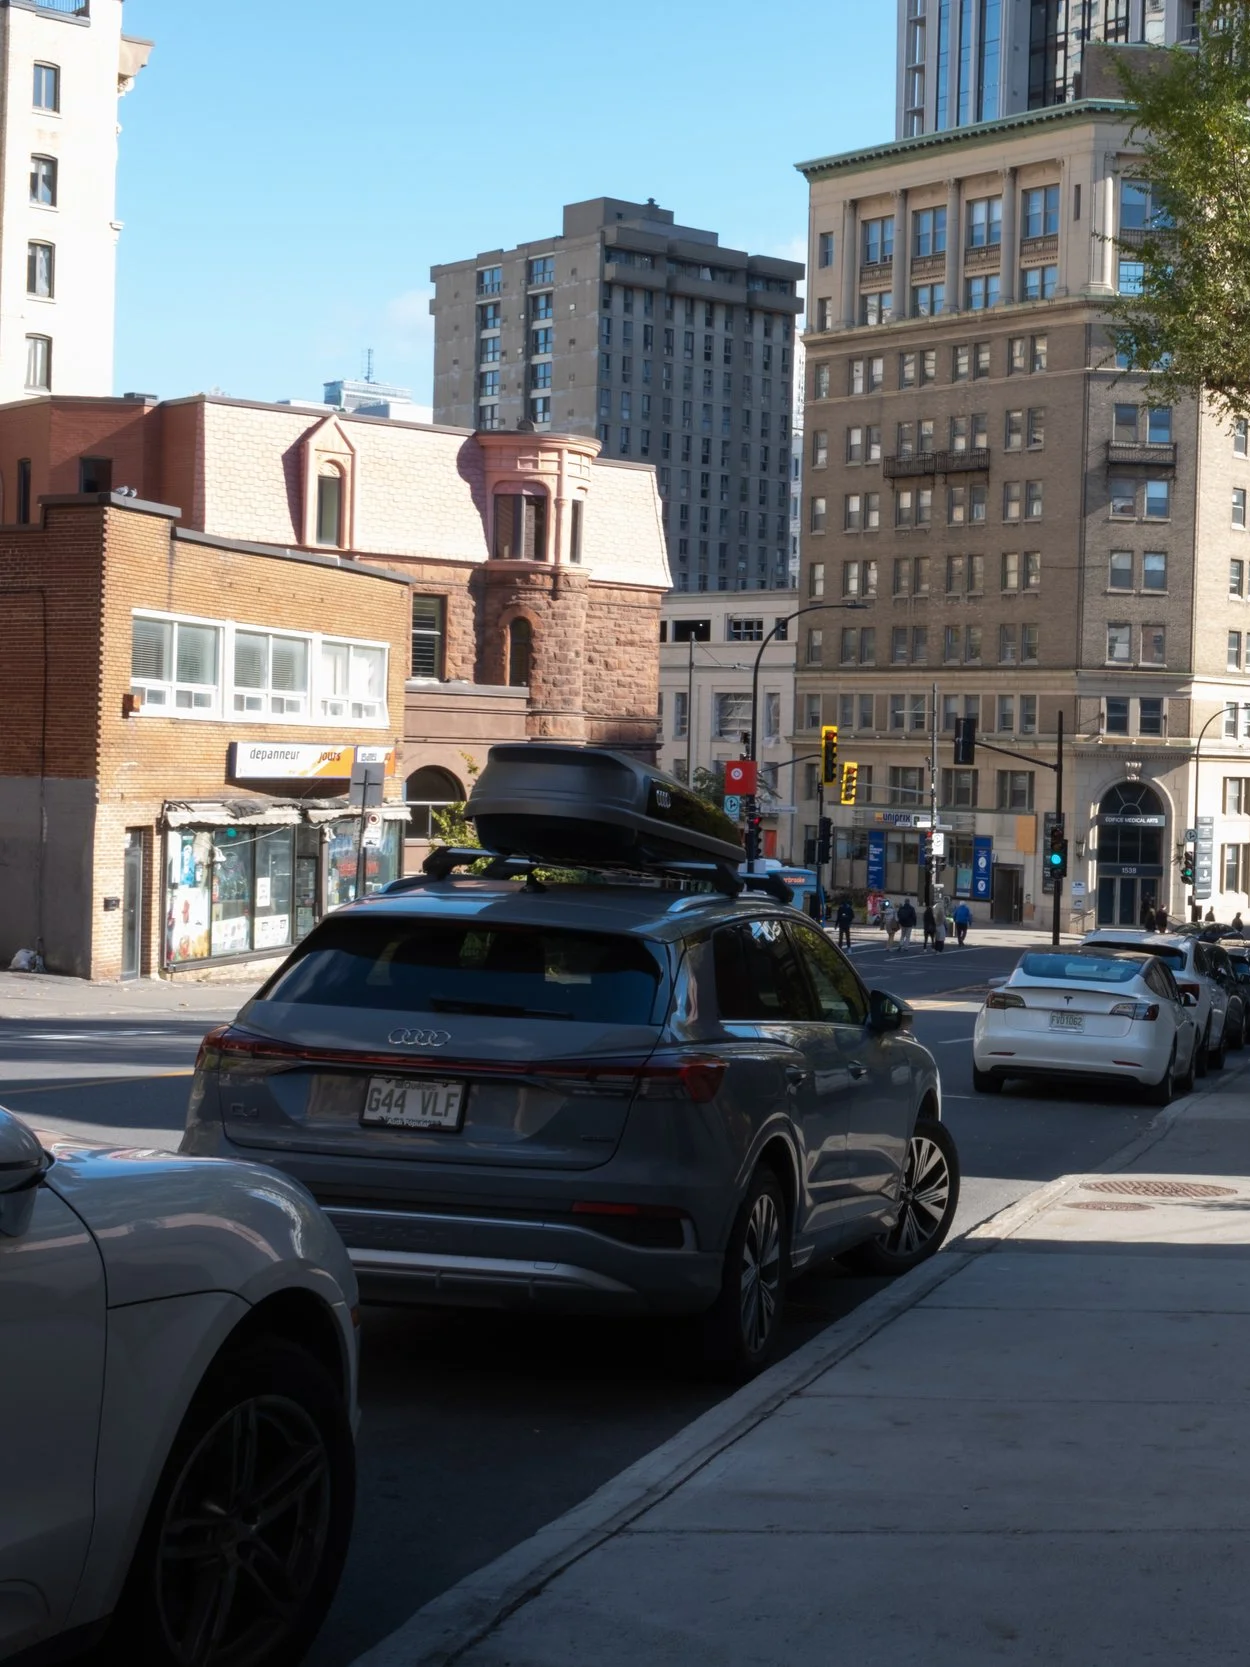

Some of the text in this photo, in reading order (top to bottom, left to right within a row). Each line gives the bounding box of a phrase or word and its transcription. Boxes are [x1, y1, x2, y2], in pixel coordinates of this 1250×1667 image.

[883, 812, 911, 824] uniprix
[367, 1087, 459, 1117] G44 VLF
